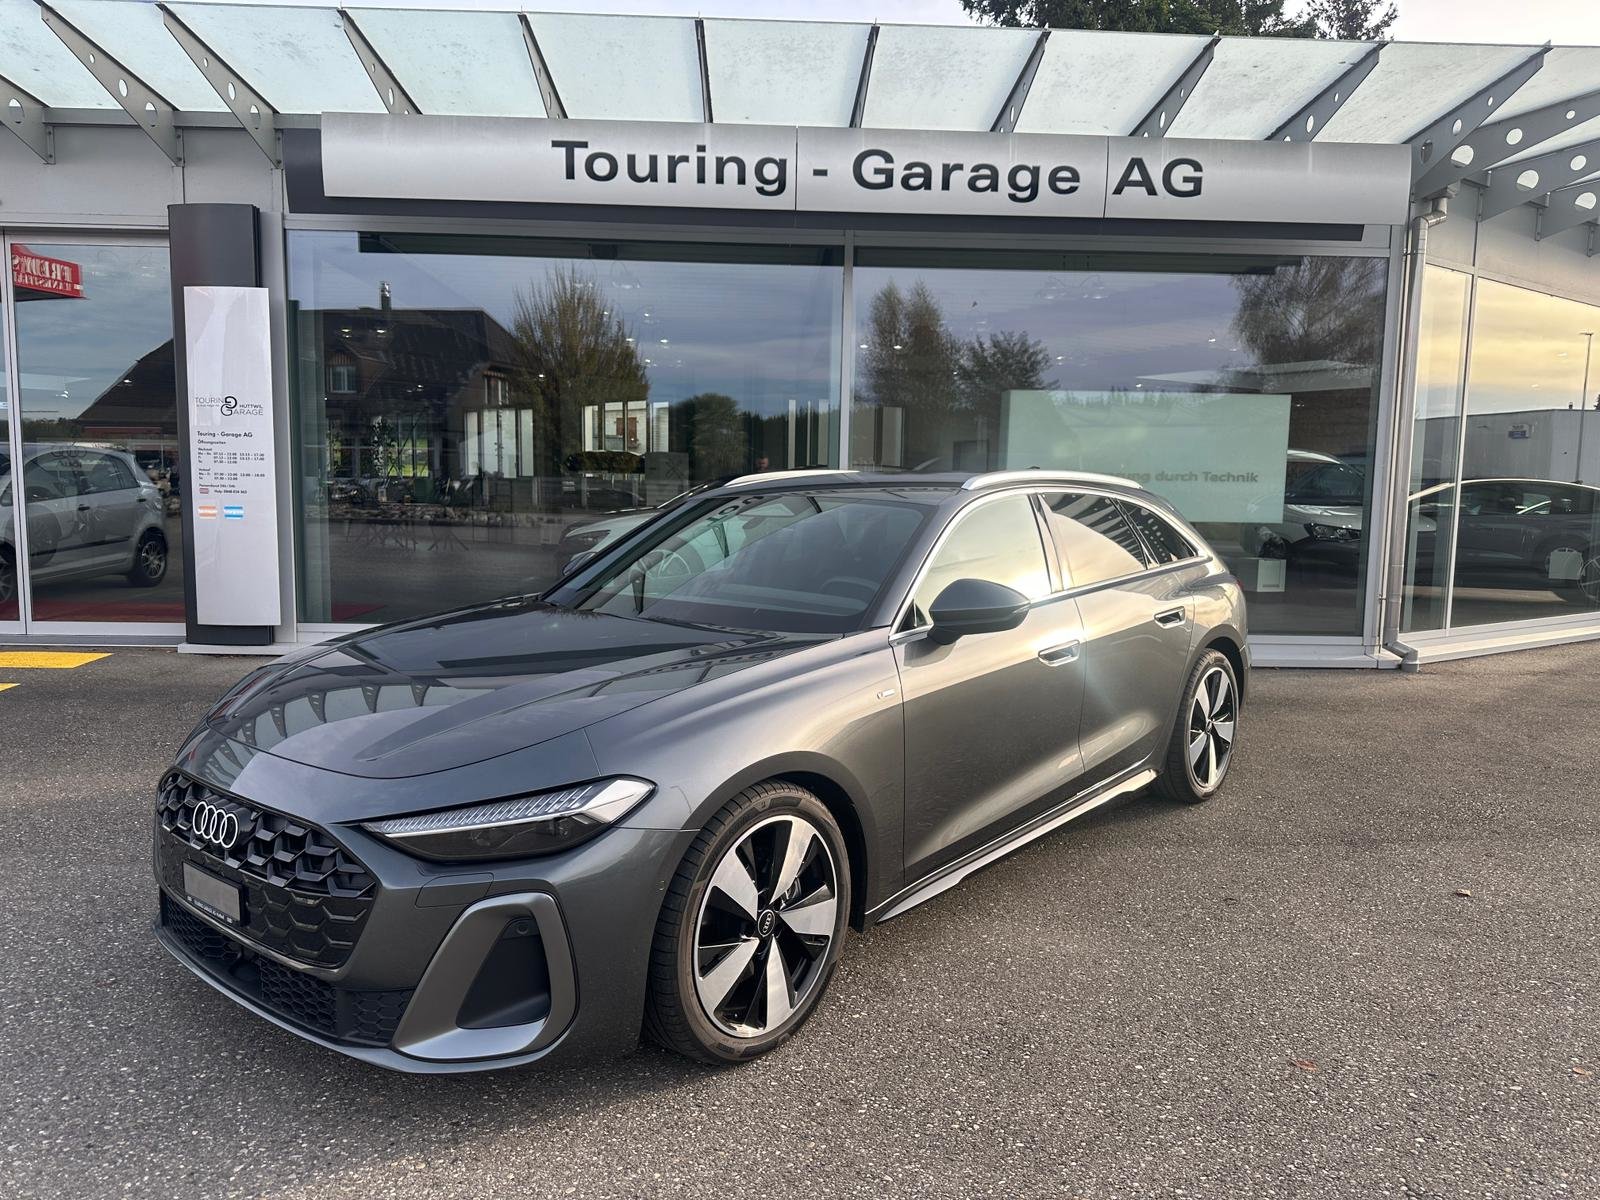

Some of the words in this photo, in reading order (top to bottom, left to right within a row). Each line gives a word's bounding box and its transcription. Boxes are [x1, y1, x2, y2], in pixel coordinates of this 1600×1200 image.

[551, 140, 787, 197] Touring
[813, 168, 829, 177] -
[852, 149, 1081, 203] Garage
[1112, 157, 1203, 198] AG
[1155, 471, 1198, 482] durch
[1202, 471, 1259, 483] Technik
